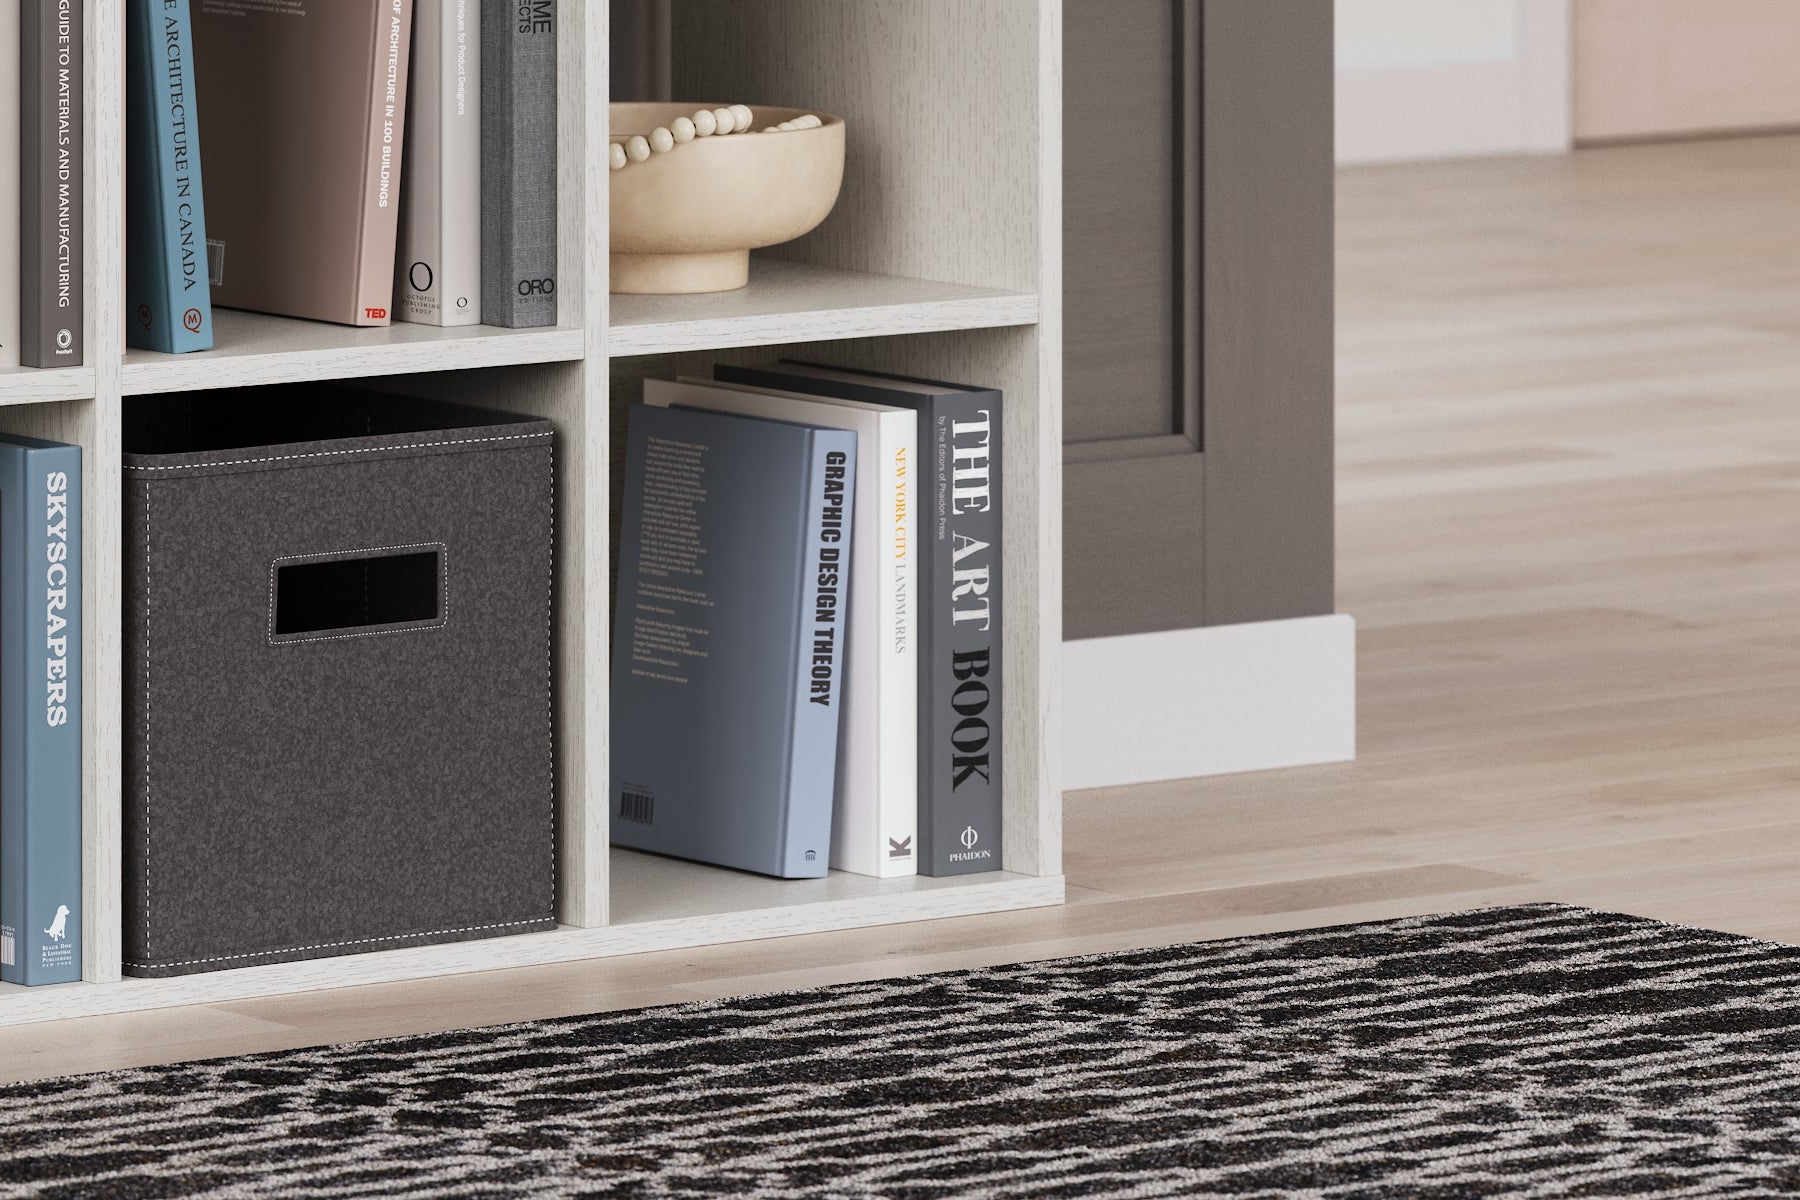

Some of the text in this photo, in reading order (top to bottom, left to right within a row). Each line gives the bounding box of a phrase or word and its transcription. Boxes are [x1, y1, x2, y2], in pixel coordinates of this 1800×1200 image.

[59, 0, 69, 43] GUIDE
[393, 0, 401, 14] OF
[458, 33, 466, 44] for
[59, 46, 69, 65] TO
[386, 17, 400, 102] ARCHITECTURE
[456, 46, 466, 75] Product
[59, 69, 70, 145] MATERIALS
[165, 17, 188, 171] ARCHITECTURE
[456, 77, 465, 115] Designers
[385, 105, 394, 117] IN
[384, 121, 392, 143] 100
[59, 149, 69, 180] AND
[379, 146, 391, 207] BUILDINGS
[177, 177, 190, 197] IN
[59, 184, 69, 307] MANUFACTURING
[179, 203, 196, 291] CANADA
[518, 278, 554, 296] ORO
[365, 308, 386, 318] TED
[938, 416, 945, 425] by
[939, 473, 946, 481] of
[896, 448, 906, 653] NEW YORK CITY LANDMARKS
[810, 452, 846, 706] GRAPHIC DESIGN THEORY
[47, 472, 66, 726] SKYSCRAPERS
[951, 410, 990, 792] THE ART BOOK
[949, 850, 990, 862] PHAIDON
